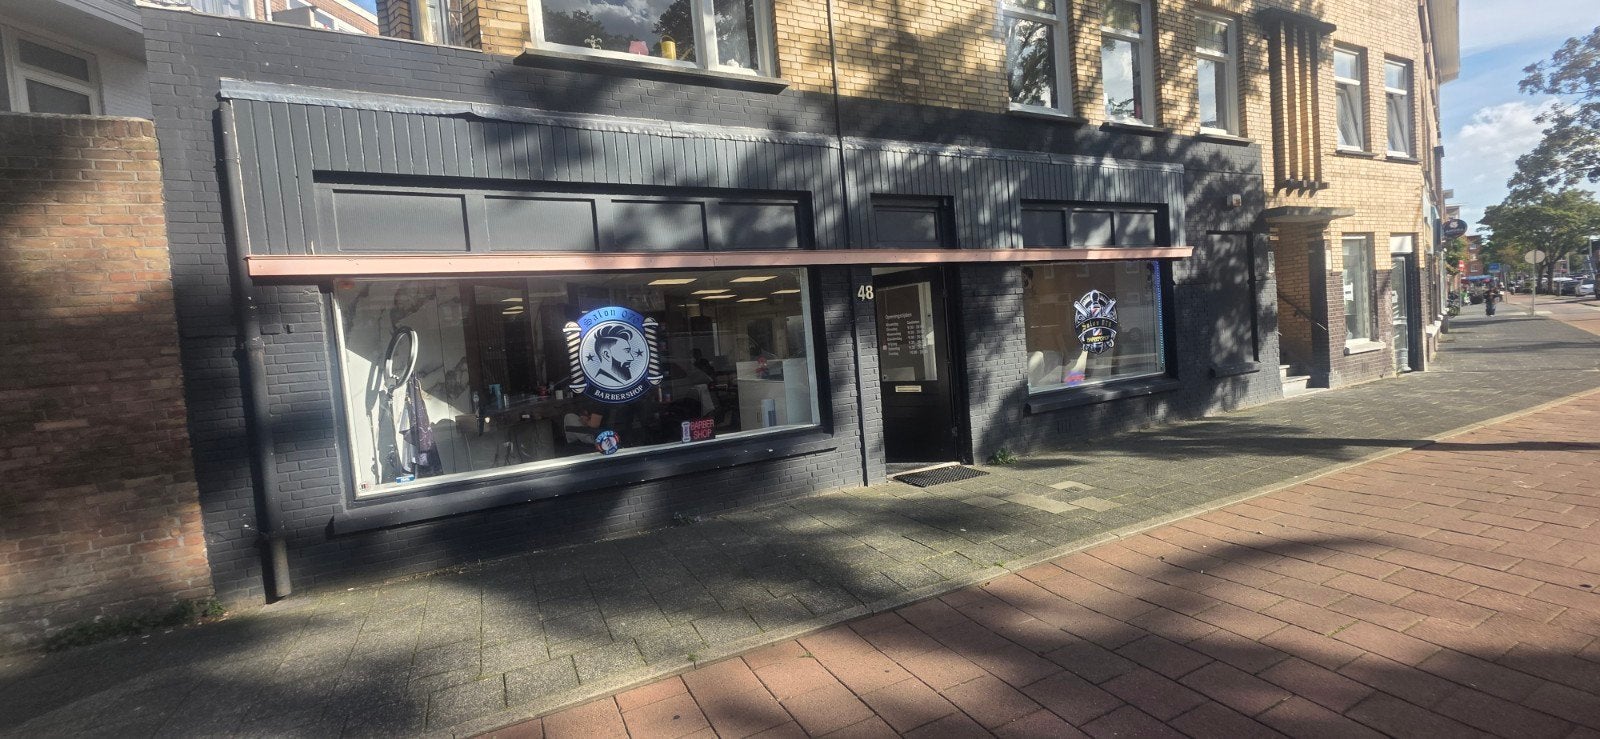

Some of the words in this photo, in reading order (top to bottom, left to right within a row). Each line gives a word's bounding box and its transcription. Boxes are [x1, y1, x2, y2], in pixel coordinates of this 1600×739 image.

[857, 285, 874, 301] 48
[584, 309, 616, 328] Salon
[594, 385, 644, 401] BARBERSHOP
[690, 419, 715, 431] BARBER
[693, 428, 712, 440] SHOP
